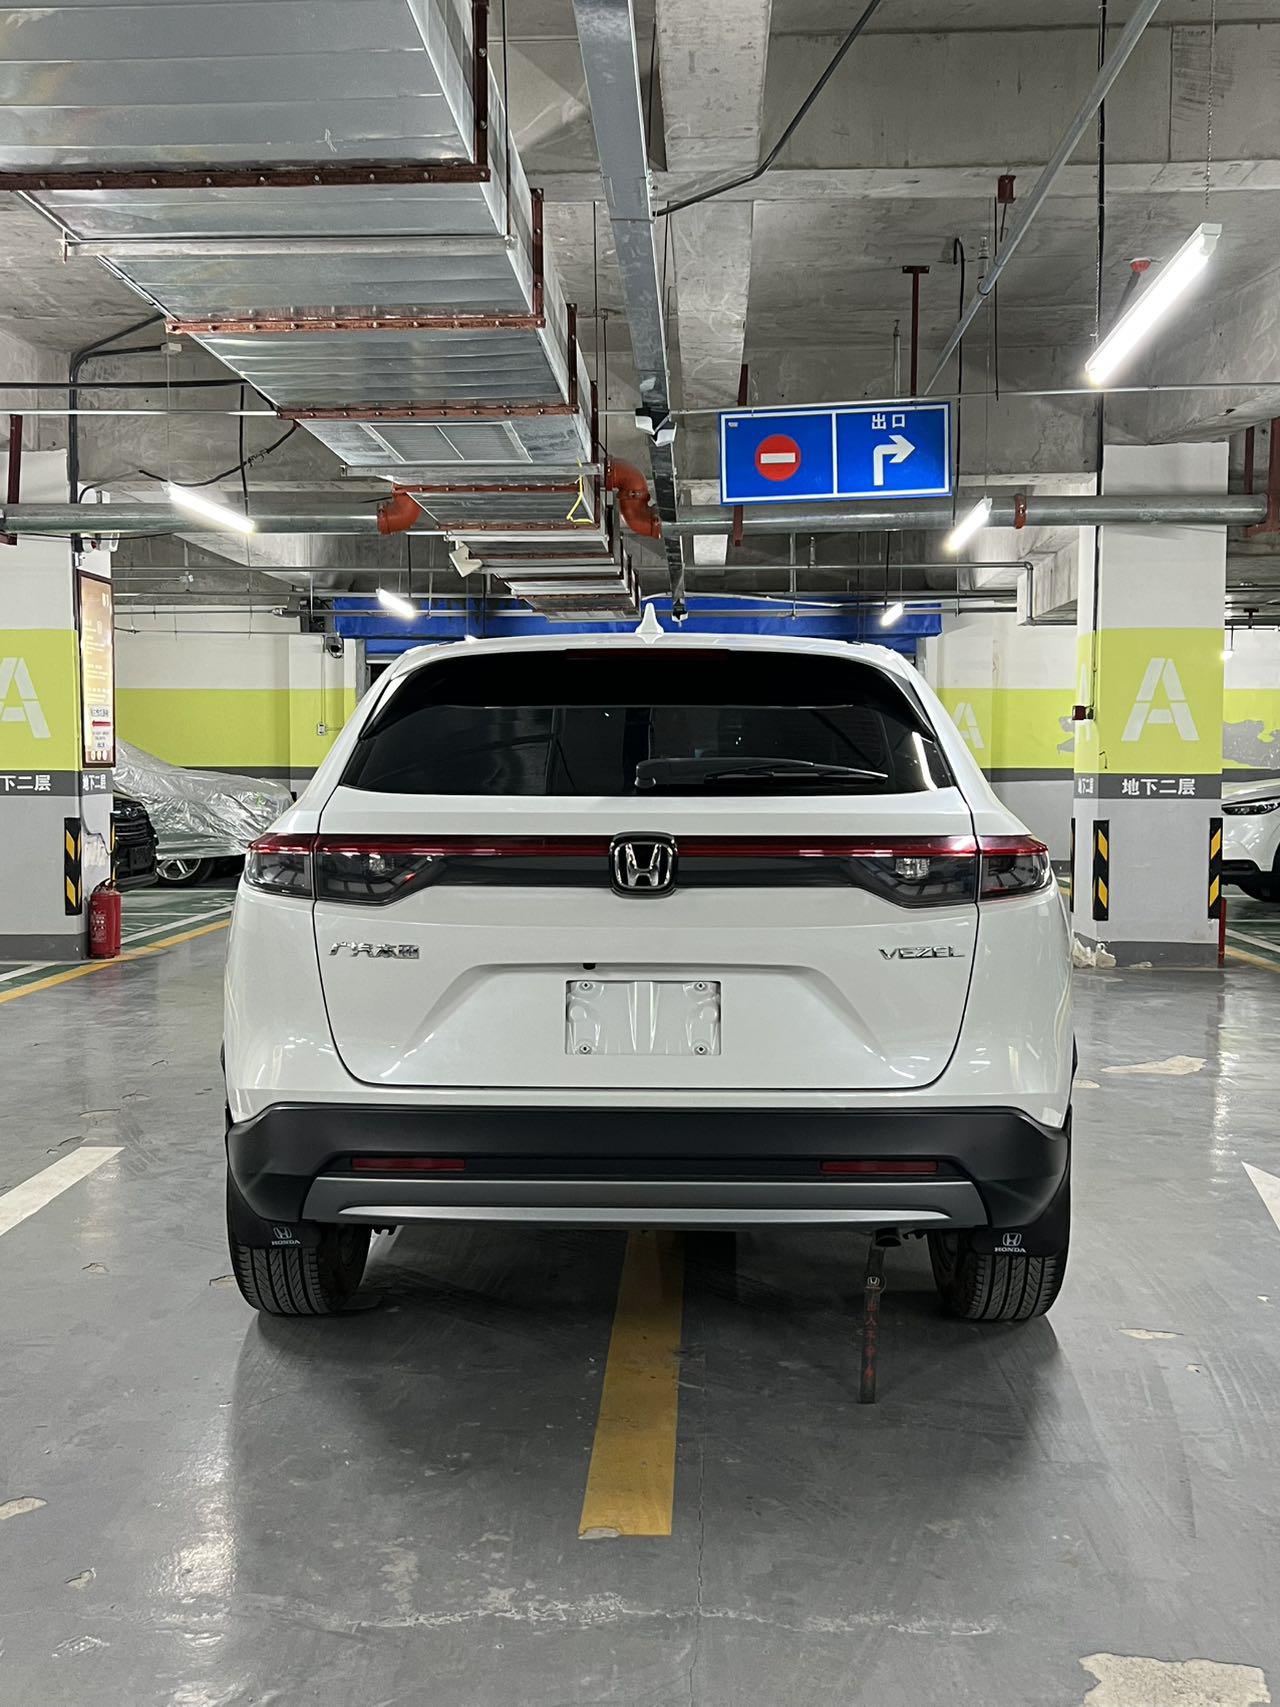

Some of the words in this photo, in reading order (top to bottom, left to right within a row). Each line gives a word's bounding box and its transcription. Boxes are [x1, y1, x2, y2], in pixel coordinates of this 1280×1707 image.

[871, 413, 906, 430] 出口
[0, 657, 51, 738] A
[1121, 657, 1200, 742] A
[1121, 778, 1196, 796] 地下二层
[879, 945, 966, 960] VEZEL
